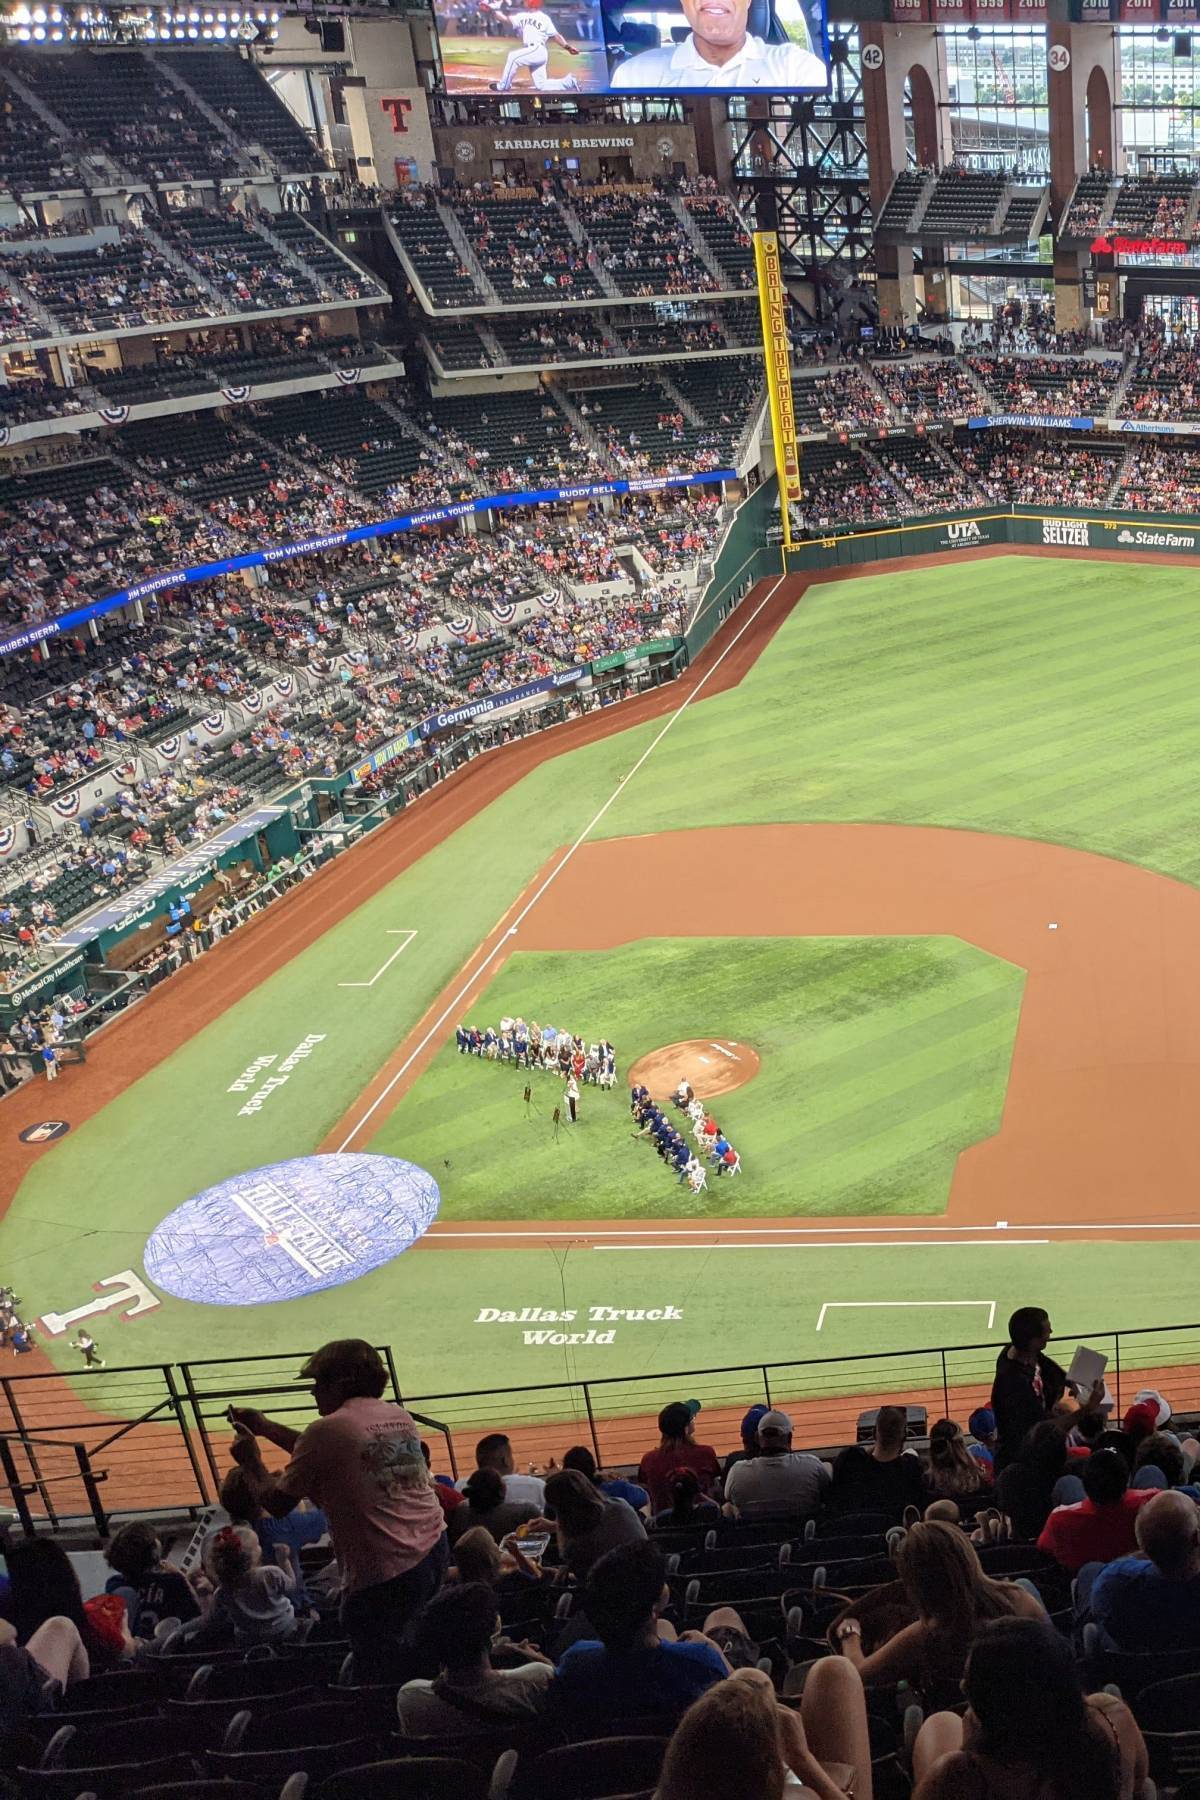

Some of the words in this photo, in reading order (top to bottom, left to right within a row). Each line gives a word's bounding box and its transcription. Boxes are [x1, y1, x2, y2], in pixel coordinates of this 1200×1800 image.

[863, 50, 882, 64] 42
[1049, 50, 1069, 65] 34
[381, 98, 412, 133] T
[494, 139, 559, 149] KARBACH
[572, 137, 634, 149] BREWING
[766, 255, 783, 332] BRING
[774, 335, 788, 382] THE
[778, 384, 794, 444] HEAT
[1136, 423, 1175, 434] Albertsons
[559, 487, 589, 498] BUDDY
[590, 484, 617, 496] BELL
[411, 509, 447, 526] MICHAEL
[448, 503, 476, 518] YOUNG
[947, 521, 981, 539] UTA
[1062, 520, 1088, 529] LIGHT
[263, 550, 284, 562] TOM
[284, 534, 348, 558] VANDERGRIFF
[1043, 526, 1089, 547] SELTZER
[127, 588, 140, 602] JIM
[140, 573, 187, 597] SUNDBERG
[0, 634, 30, 655] RUBEN
[30, 622, 60, 643] SIERRA
[437, 698, 494, 728] Germania
[494, 686, 541, 708] INSURANCE
[181, 838, 235, 869] TEXAS
[174, 860, 213, 889] GEICO
[107, 868, 185, 913] RANGERS
[108, 898, 156, 932] GEICO
[21, 980, 44, 1000] Medical
[43, 972, 56, 986] City
[54, 954, 84, 977] Healthcare
[277, 1033, 327, 1073] Dallas
[226, 1054, 278, 1093] World
[236, 1074, 290, 1116] Truck
[290, 1227, 351, 1274] FAME
[35, 1268, 161, 1340] T
[473, 1307, 578, 1323] Dallas
[588, 1305, 684, 1321] Truck
[522, 1329, 617, 1345] World
